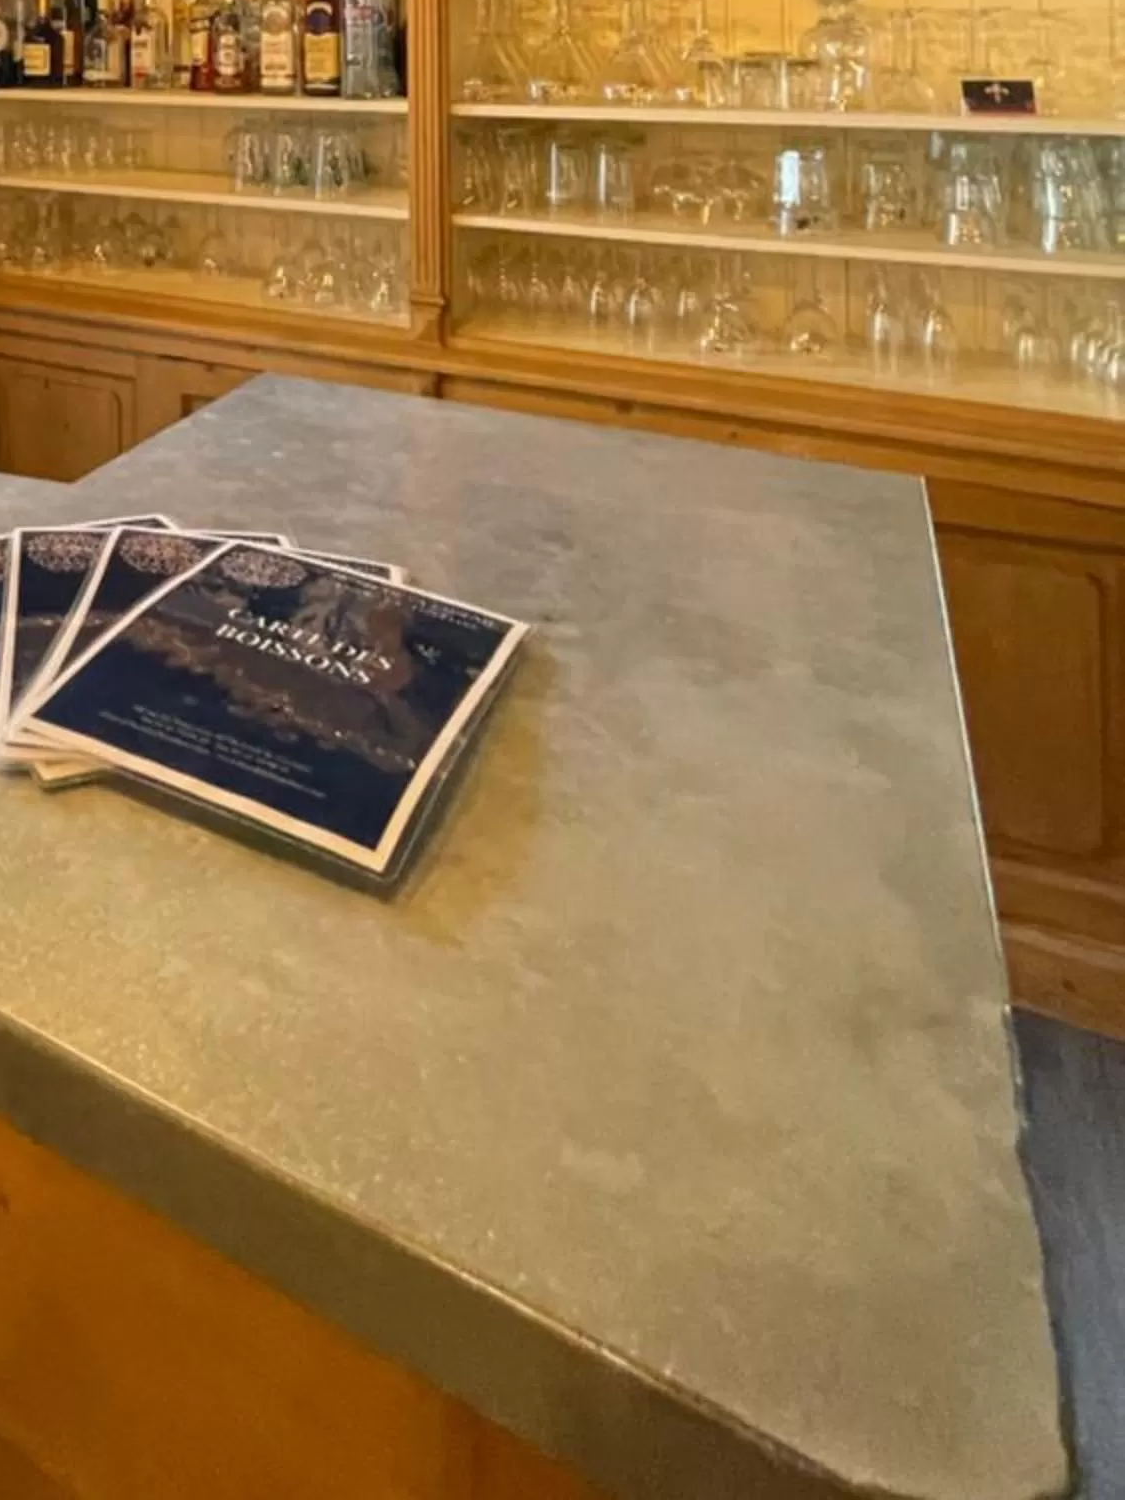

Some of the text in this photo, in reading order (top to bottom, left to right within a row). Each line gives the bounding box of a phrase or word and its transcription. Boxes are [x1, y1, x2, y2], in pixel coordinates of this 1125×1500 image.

[214, 622, 372, 685] BOISSONS
[226, 606, 392, 671] CARTE DES
